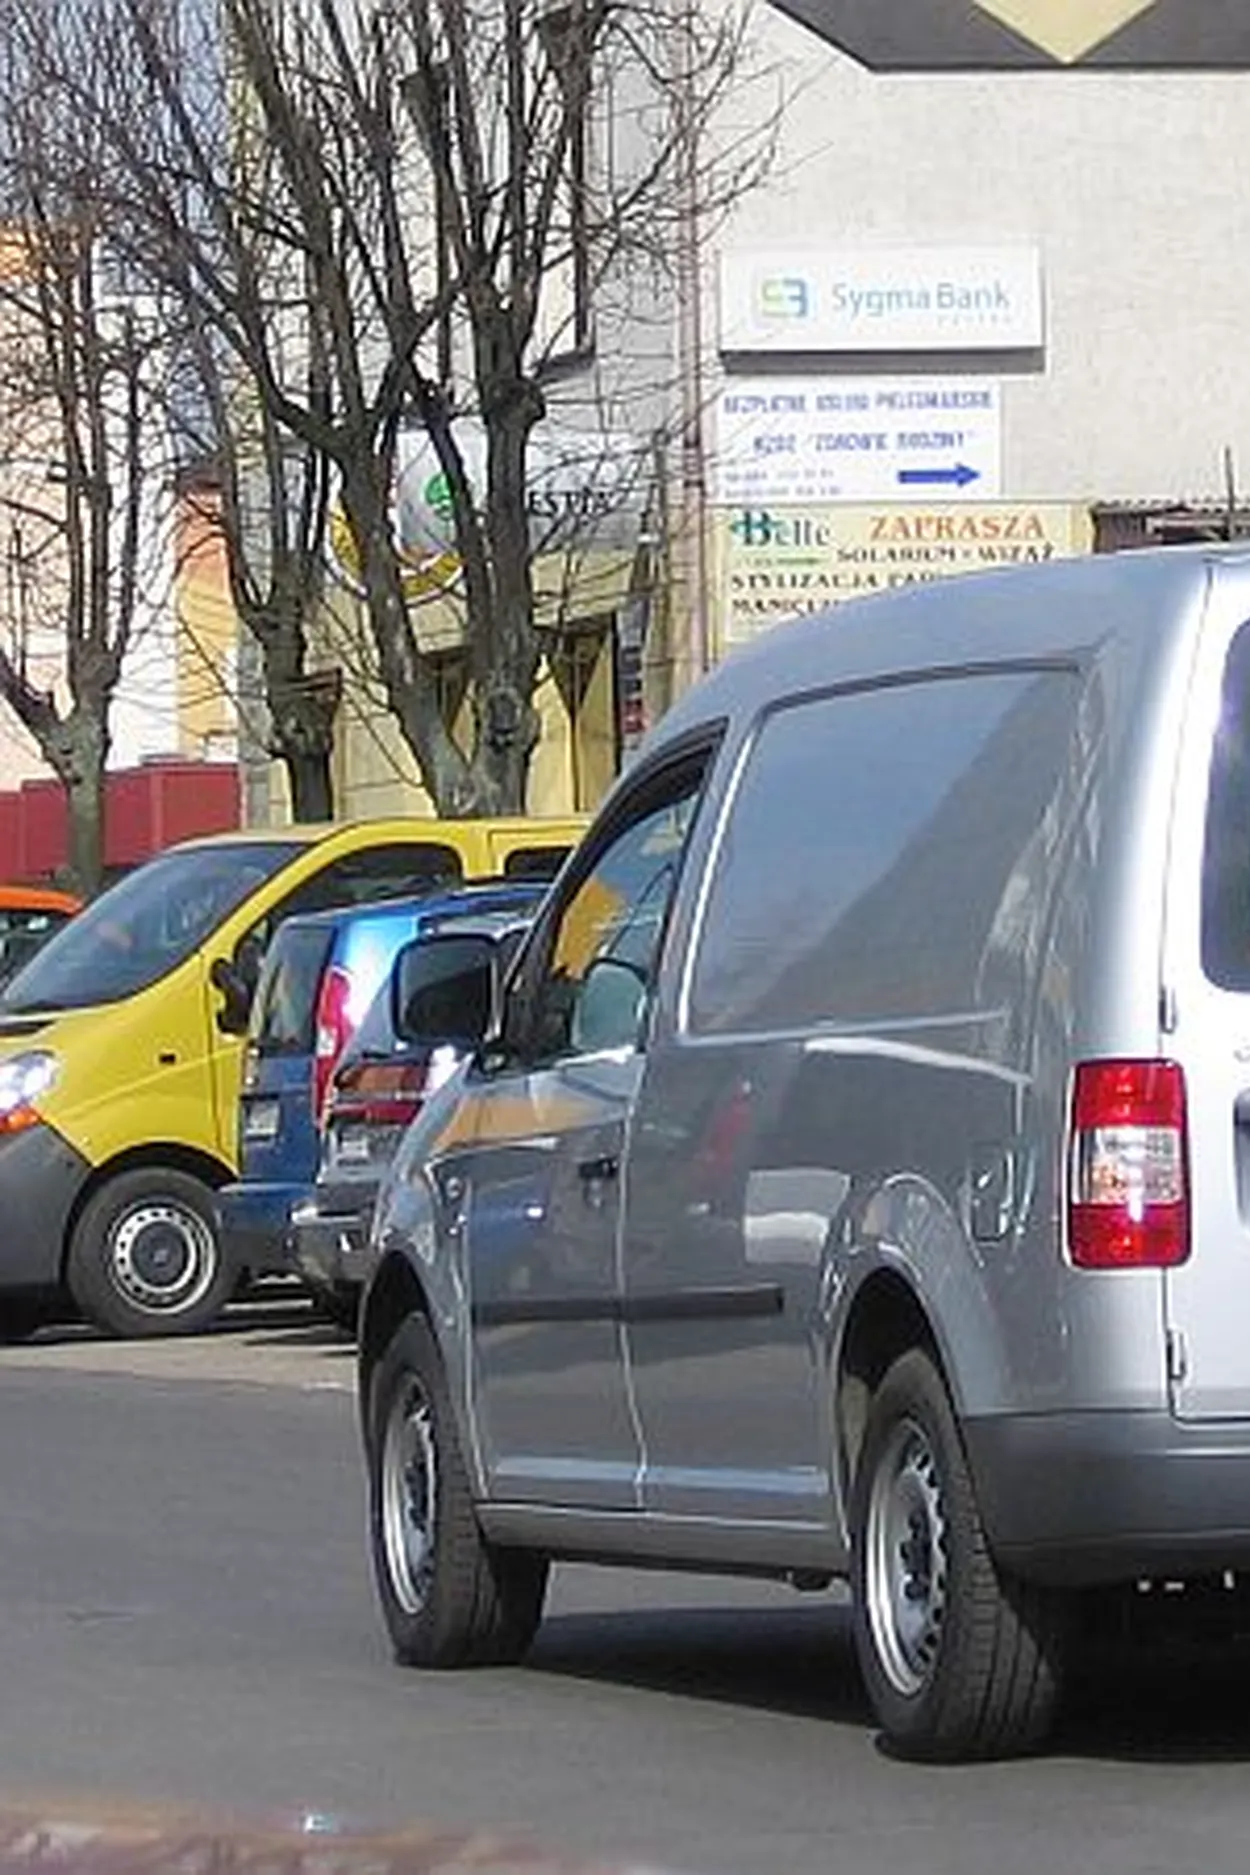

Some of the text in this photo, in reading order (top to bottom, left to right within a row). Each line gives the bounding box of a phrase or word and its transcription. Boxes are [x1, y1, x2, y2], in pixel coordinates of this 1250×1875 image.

[831, 280, 1011, 321] Sygma Bank
[730, 511, 831, 547] Belle
[869, 514, 1048, 541] ZAPRASZA
[732, 572, 878, 590] STYLIZACJA
